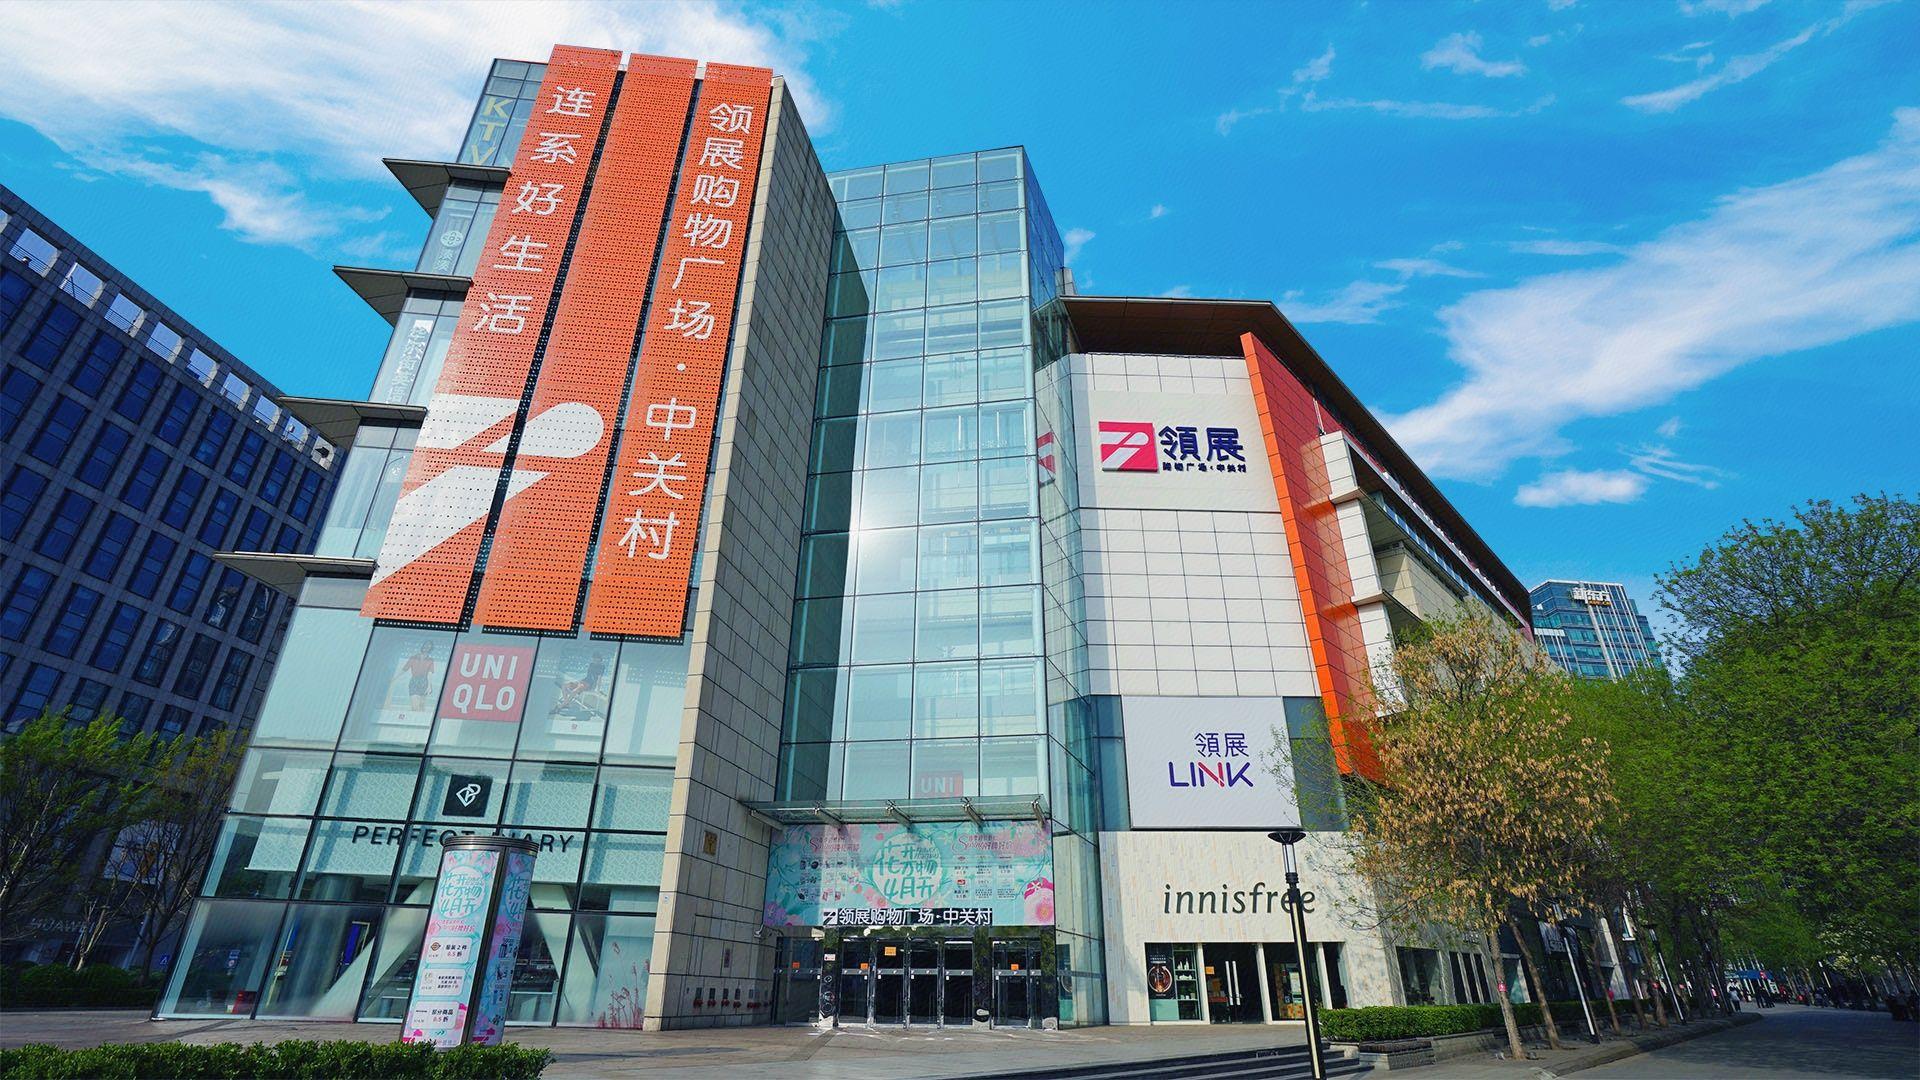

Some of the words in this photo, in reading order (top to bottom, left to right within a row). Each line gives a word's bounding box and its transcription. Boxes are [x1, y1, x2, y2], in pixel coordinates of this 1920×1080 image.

[471, 96, 514, 165] KTV
[473, 86, 596, 333] 连系好生活
[1158, 425, 1246, 462] 領展
[459, 653, 519, 681] UNI
[452, 684, 517, 714] QLO
[1194, 732, 1249, 757] 領展
[920, 776, 955, 794] UNI
[1168, 761, 1254, 787] LINK
[352, 825, 475, 848] PERFEC
[1163, 881, 1316, 914] innisfree
[839, 908, 992, 925] 领展购物广场·中关村
